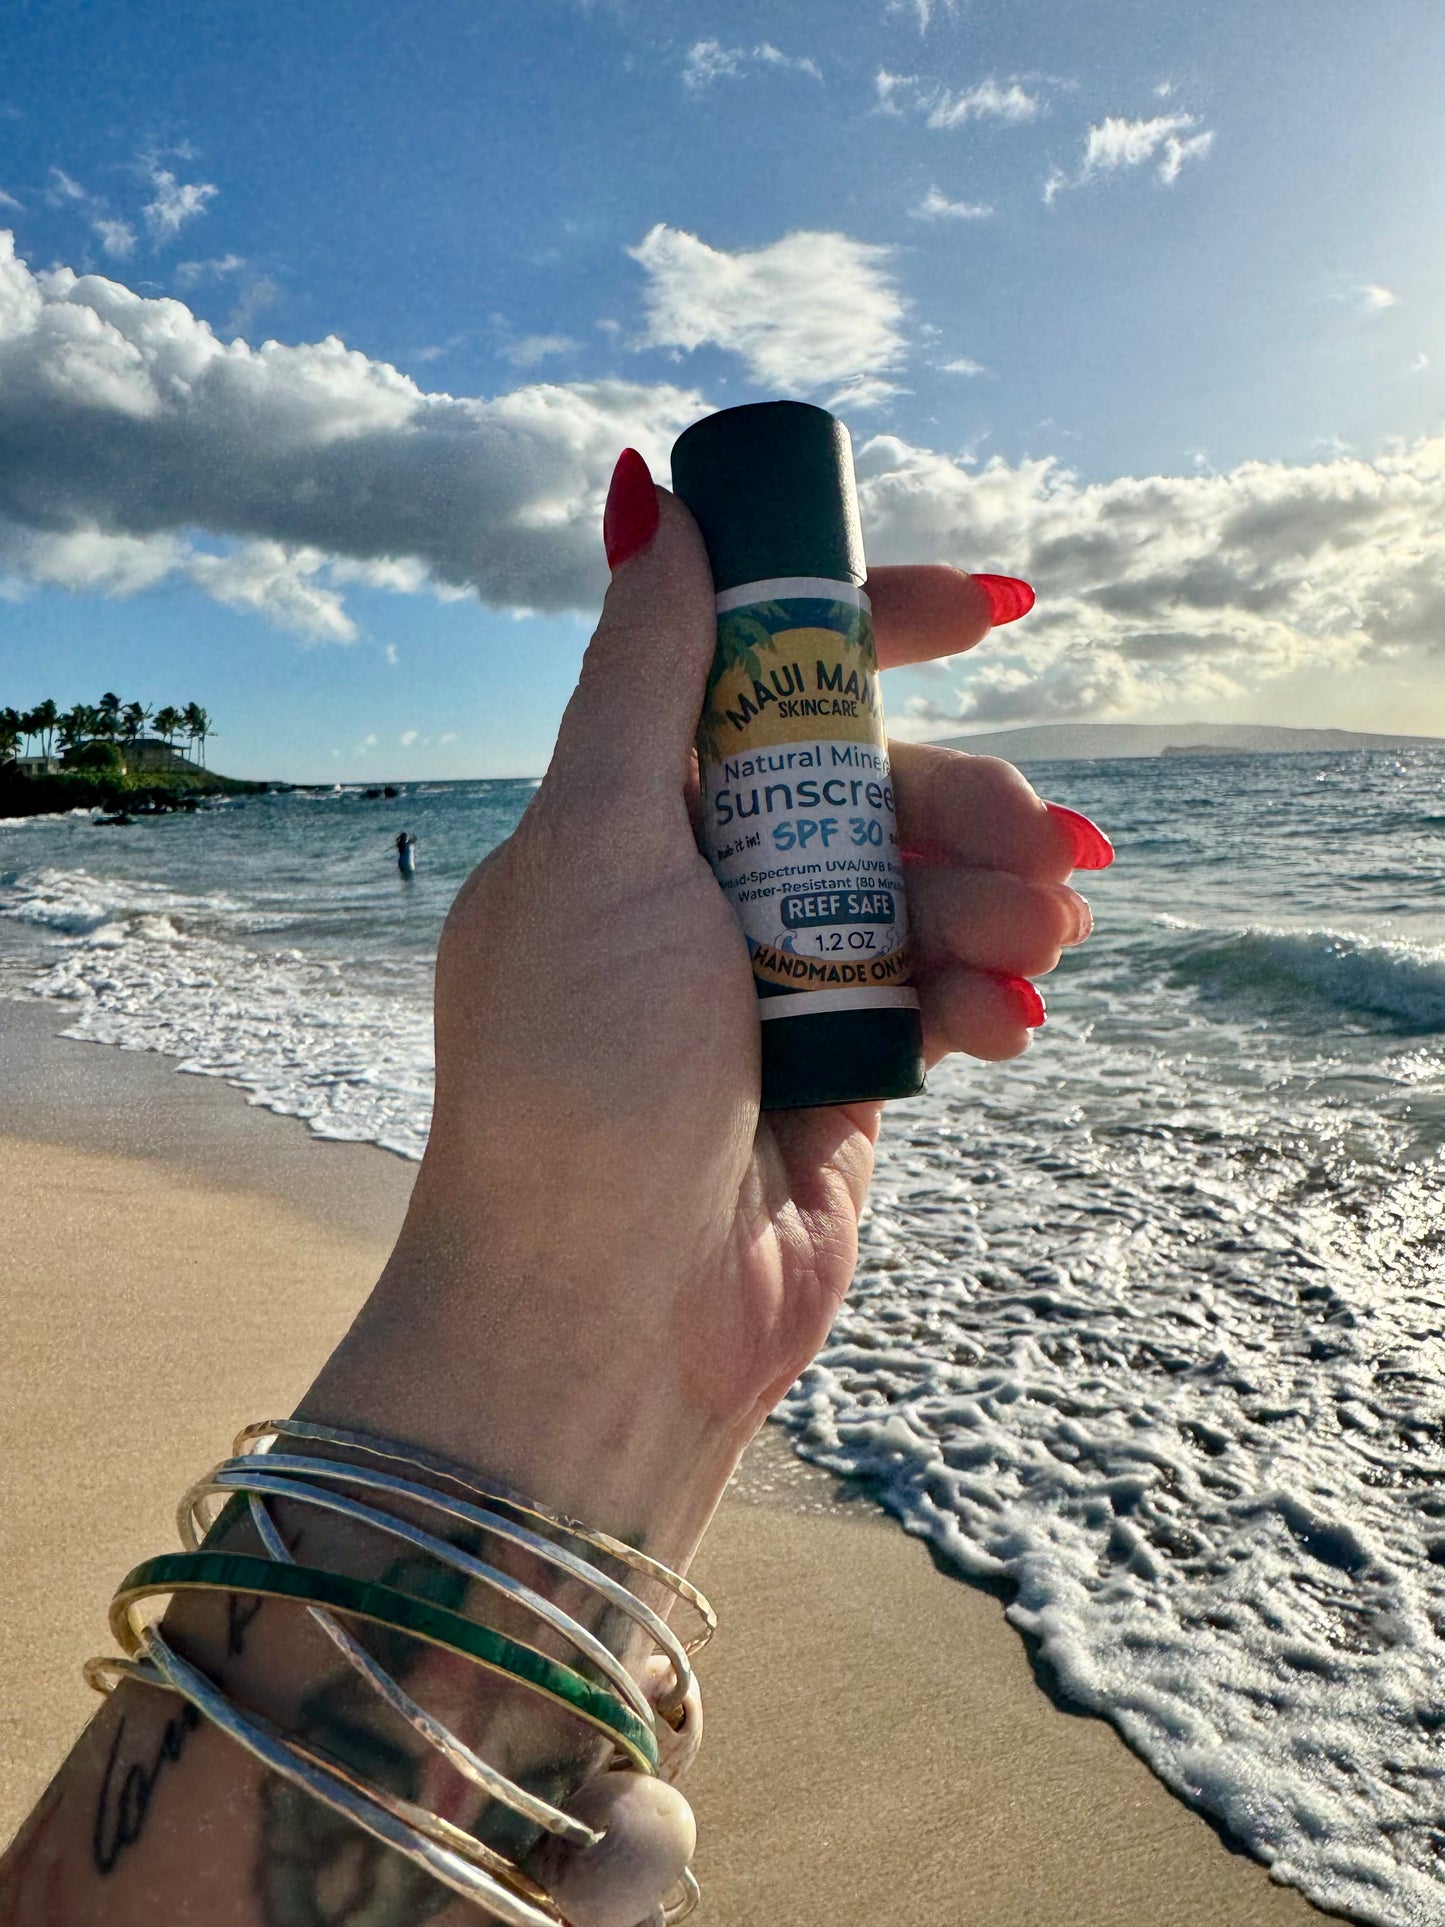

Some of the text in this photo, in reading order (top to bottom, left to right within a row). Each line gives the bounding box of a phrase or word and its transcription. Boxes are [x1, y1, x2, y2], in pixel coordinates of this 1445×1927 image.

[725, 662, 804, 731] MAUI
[779, 698, 859, 719] SKINCARE
[725, 745, 822, 783] Natural
[735, 838, 745, 853] it
[745, 832, 761, 849] in!
[772, 818, 838, 850] SPF
[849, 817, 883, 847] 30
[826, 859, 886, 873] UVA/UVB
[738, 877, 852, 903] Water-Resistant
[788, 894, 891, 919] REEF SAFE
[815, 931, 876, 952] 1.2 OZ
[754, 945, 868, 983] HANDMADE
[870, 958, 898, 981] ON
